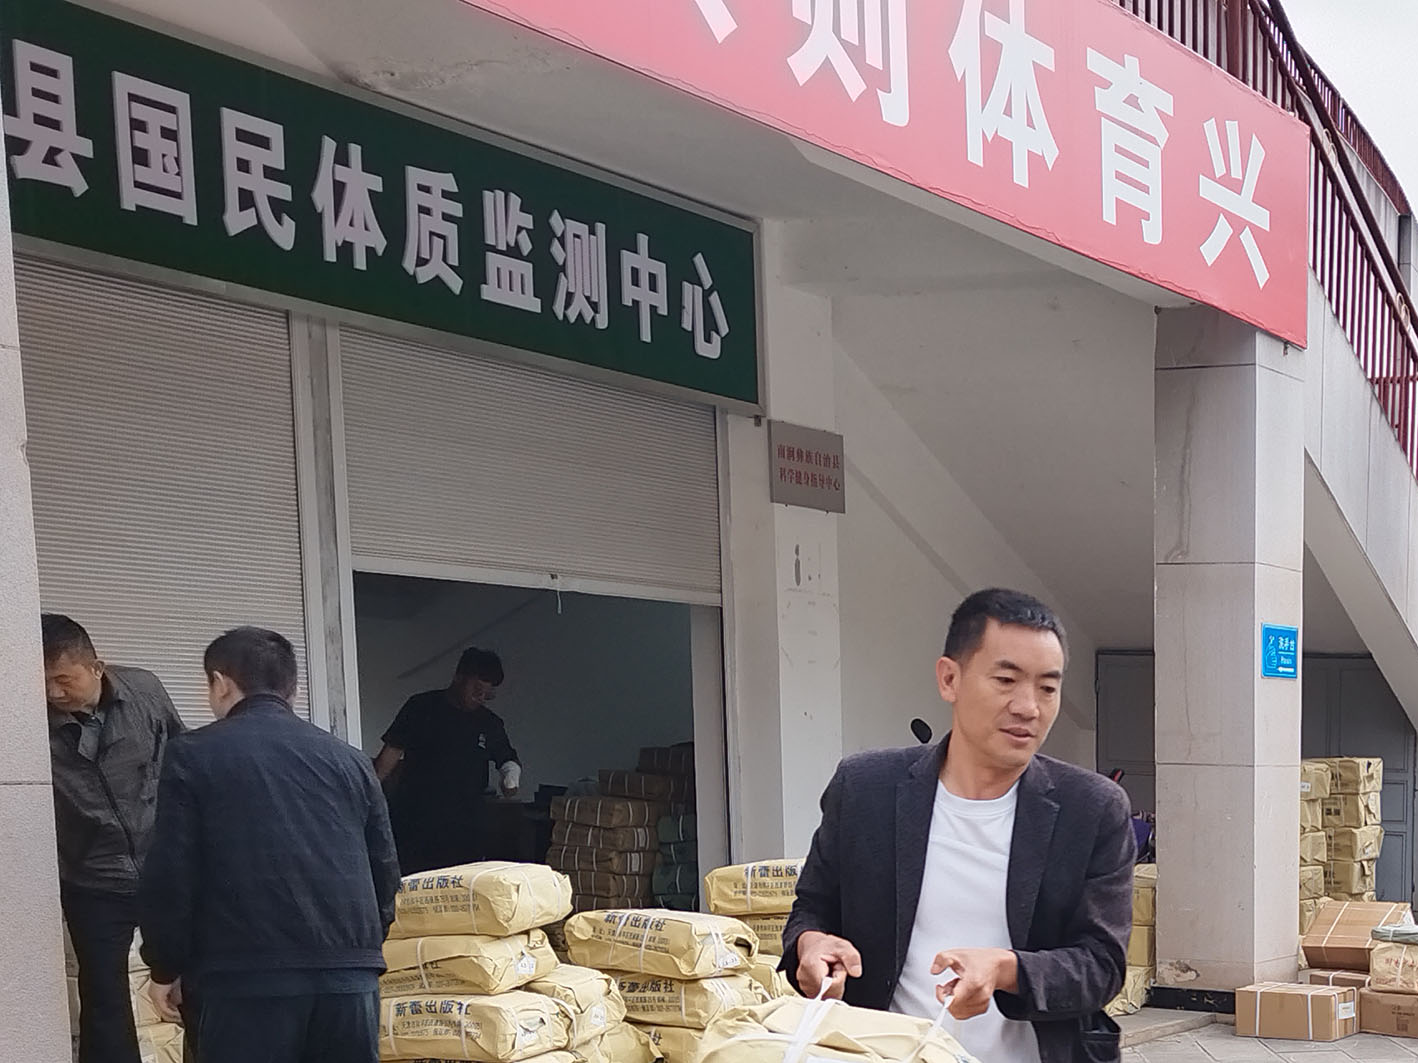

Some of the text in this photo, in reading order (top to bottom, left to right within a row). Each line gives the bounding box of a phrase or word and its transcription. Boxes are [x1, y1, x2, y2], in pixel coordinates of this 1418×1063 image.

[4, 38, 731, 361] 县国民体质监测中心
[695, 0, 1271, 289] 则体育兴
[394, 1000, 472, 1017] 新蕾出版社
